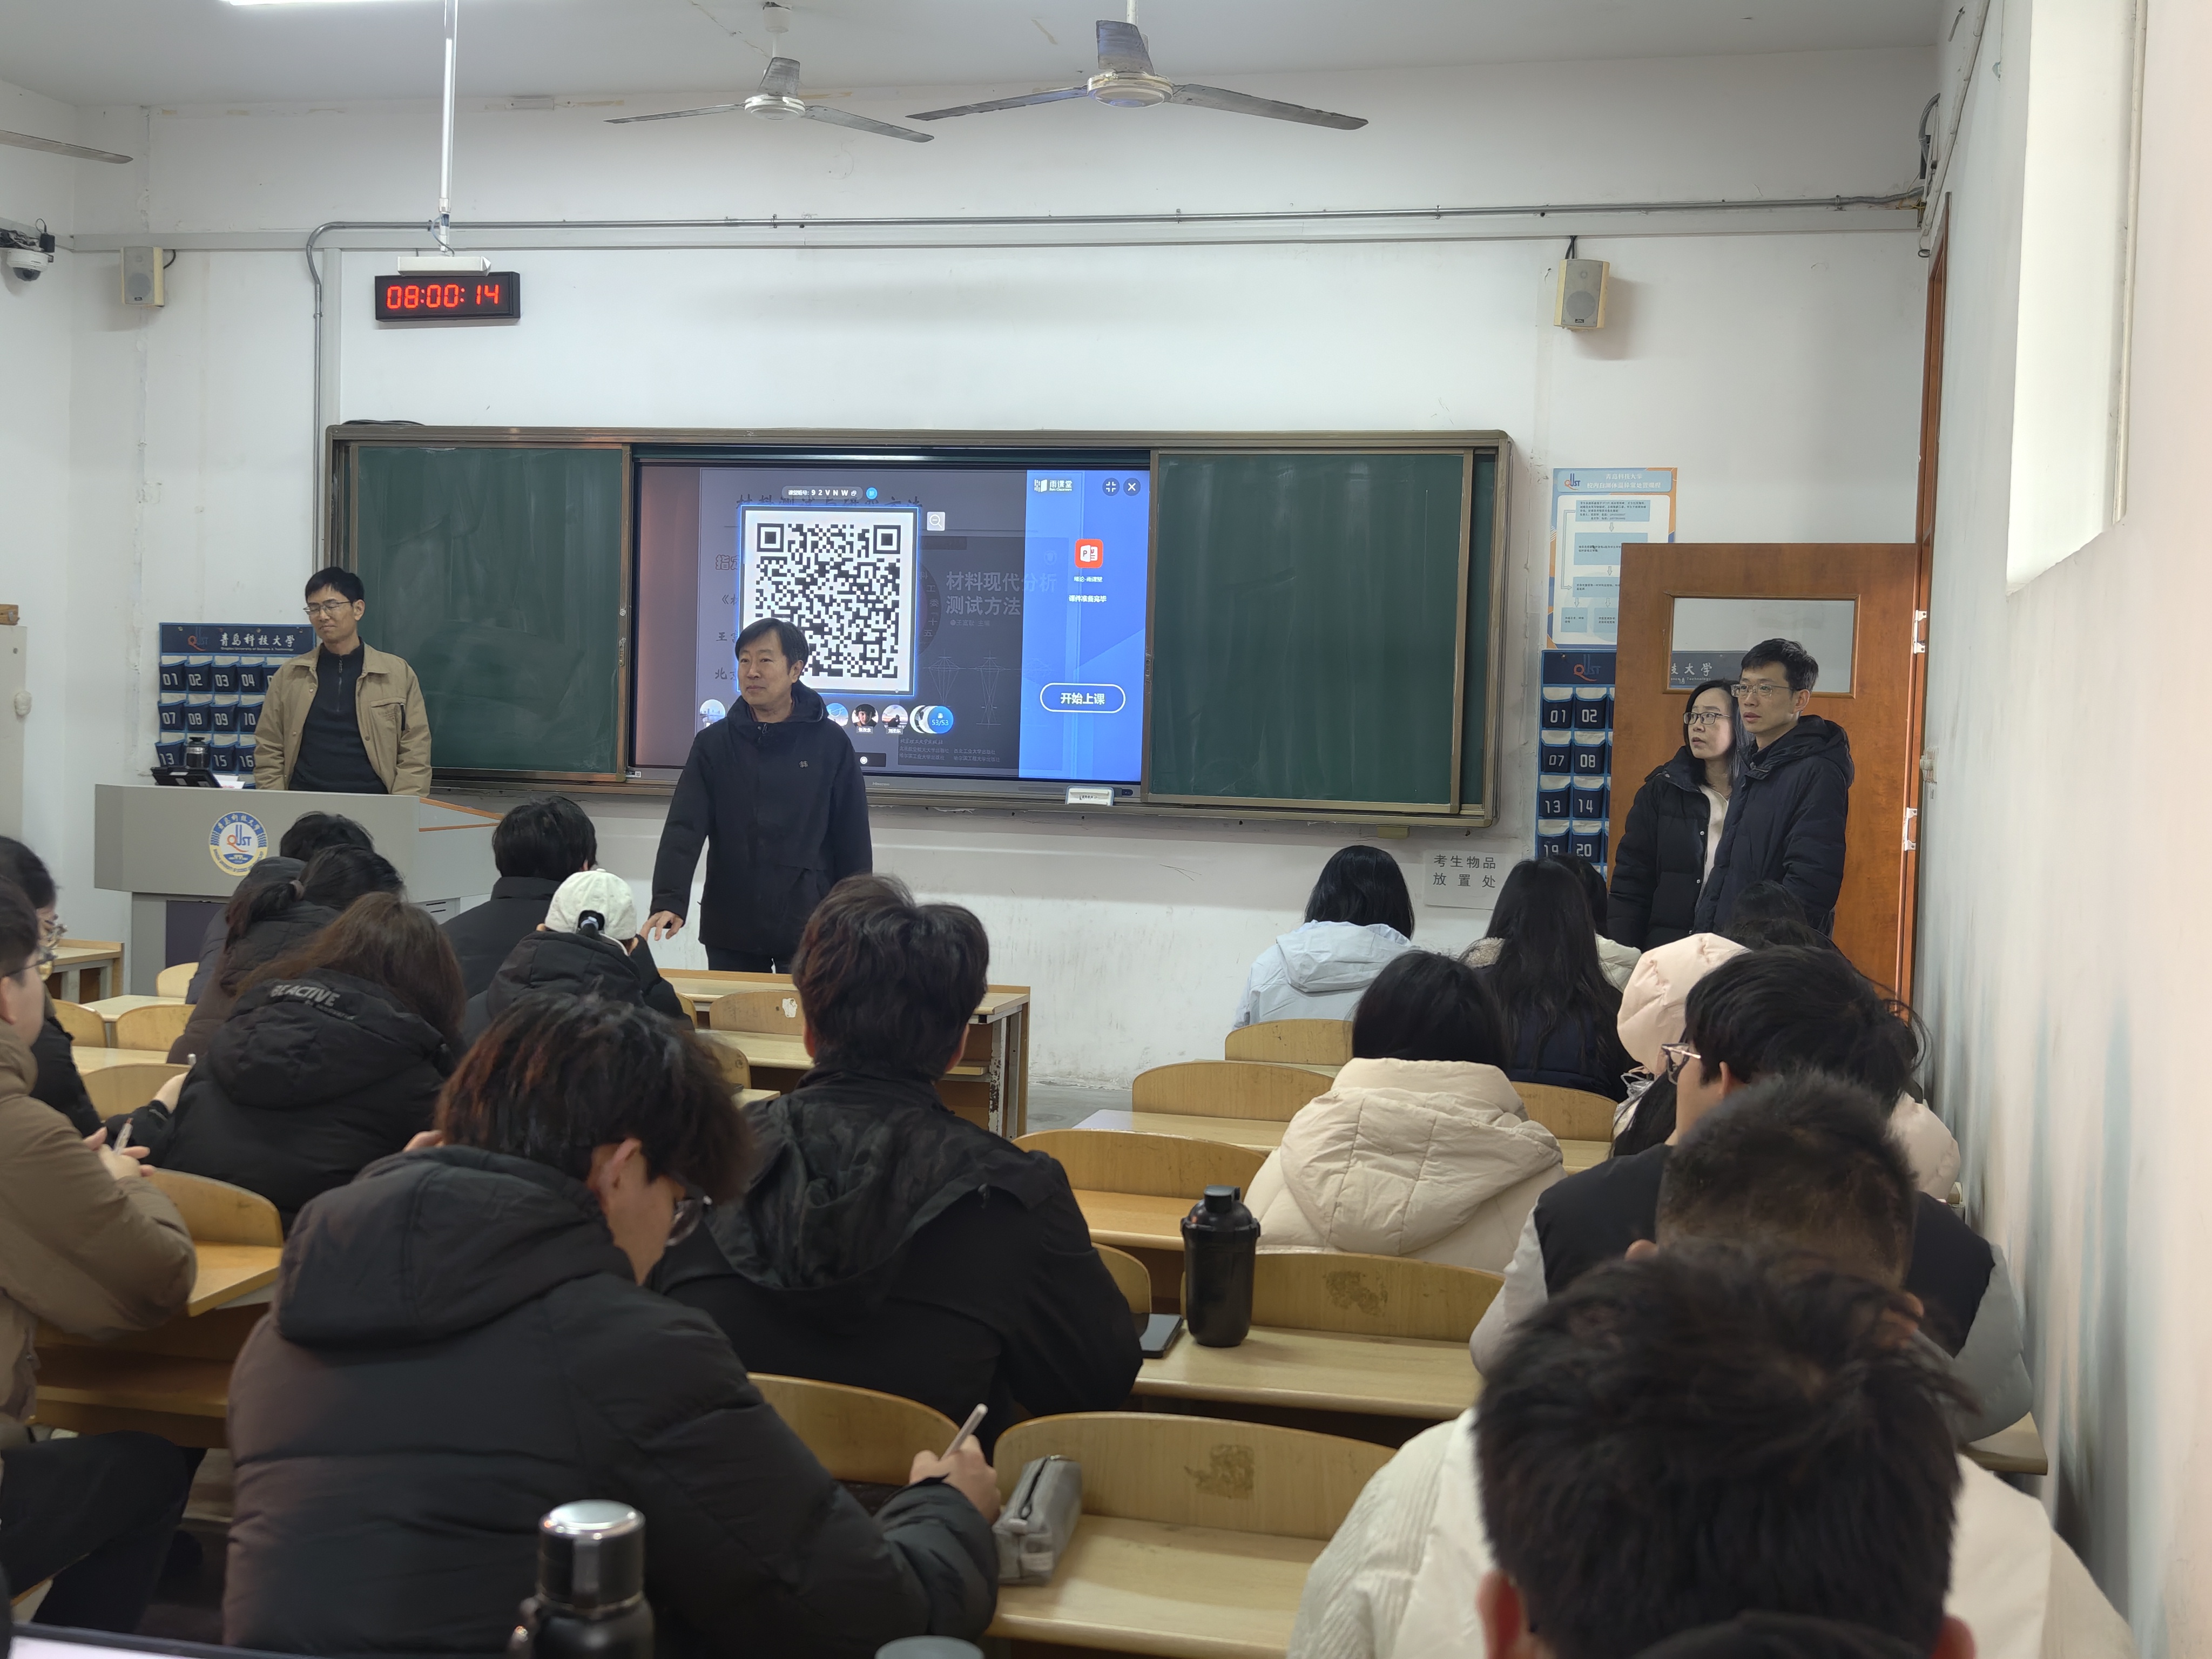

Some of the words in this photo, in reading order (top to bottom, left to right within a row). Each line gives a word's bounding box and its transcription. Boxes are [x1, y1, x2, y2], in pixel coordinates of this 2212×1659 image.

[386, 284, 500, 309] 08:00:14
[1049, 480, 1073, 488] 雨课堂
[946, 571, 1057, 592] 材料现代分析
[946, 595, 1021, 616] 测试方法
[163, 673, 178, 685] 01
[188, 673, 203, 686] 02
[215, 675, 230, 687] 03
[241, 674, 255, 687] 04
[1060, 692, 1105, 705] 开始上课
[162, 712, 176, 725] 07
[188, 712, 203, 725] 08
[214, 713, 229, 726] 09
[244, 712, 256, 726] 10
[1550, 710, 1566, 723] 01
[1582, 709, 1597, 723] 02
[159, 753, 174, 765] 13
[213, 754, 227, 767] 15
[239, 755, 254, 767] 16
[1548, 754, 1564, 767] 07
[1580, 754, 1596, 767] 08
[1545, 800, 1561, 814] 13
[1578, 798, 1593, 813] 14
[227, 824, 252, 852] QUST
[1576, 844, 1592, 857] 20
[1434, 854, 1496, 869] 考生物品
[1433, 872, 1496, 888] 放置处
[285, 985, 341, 1007] ACTIVE
